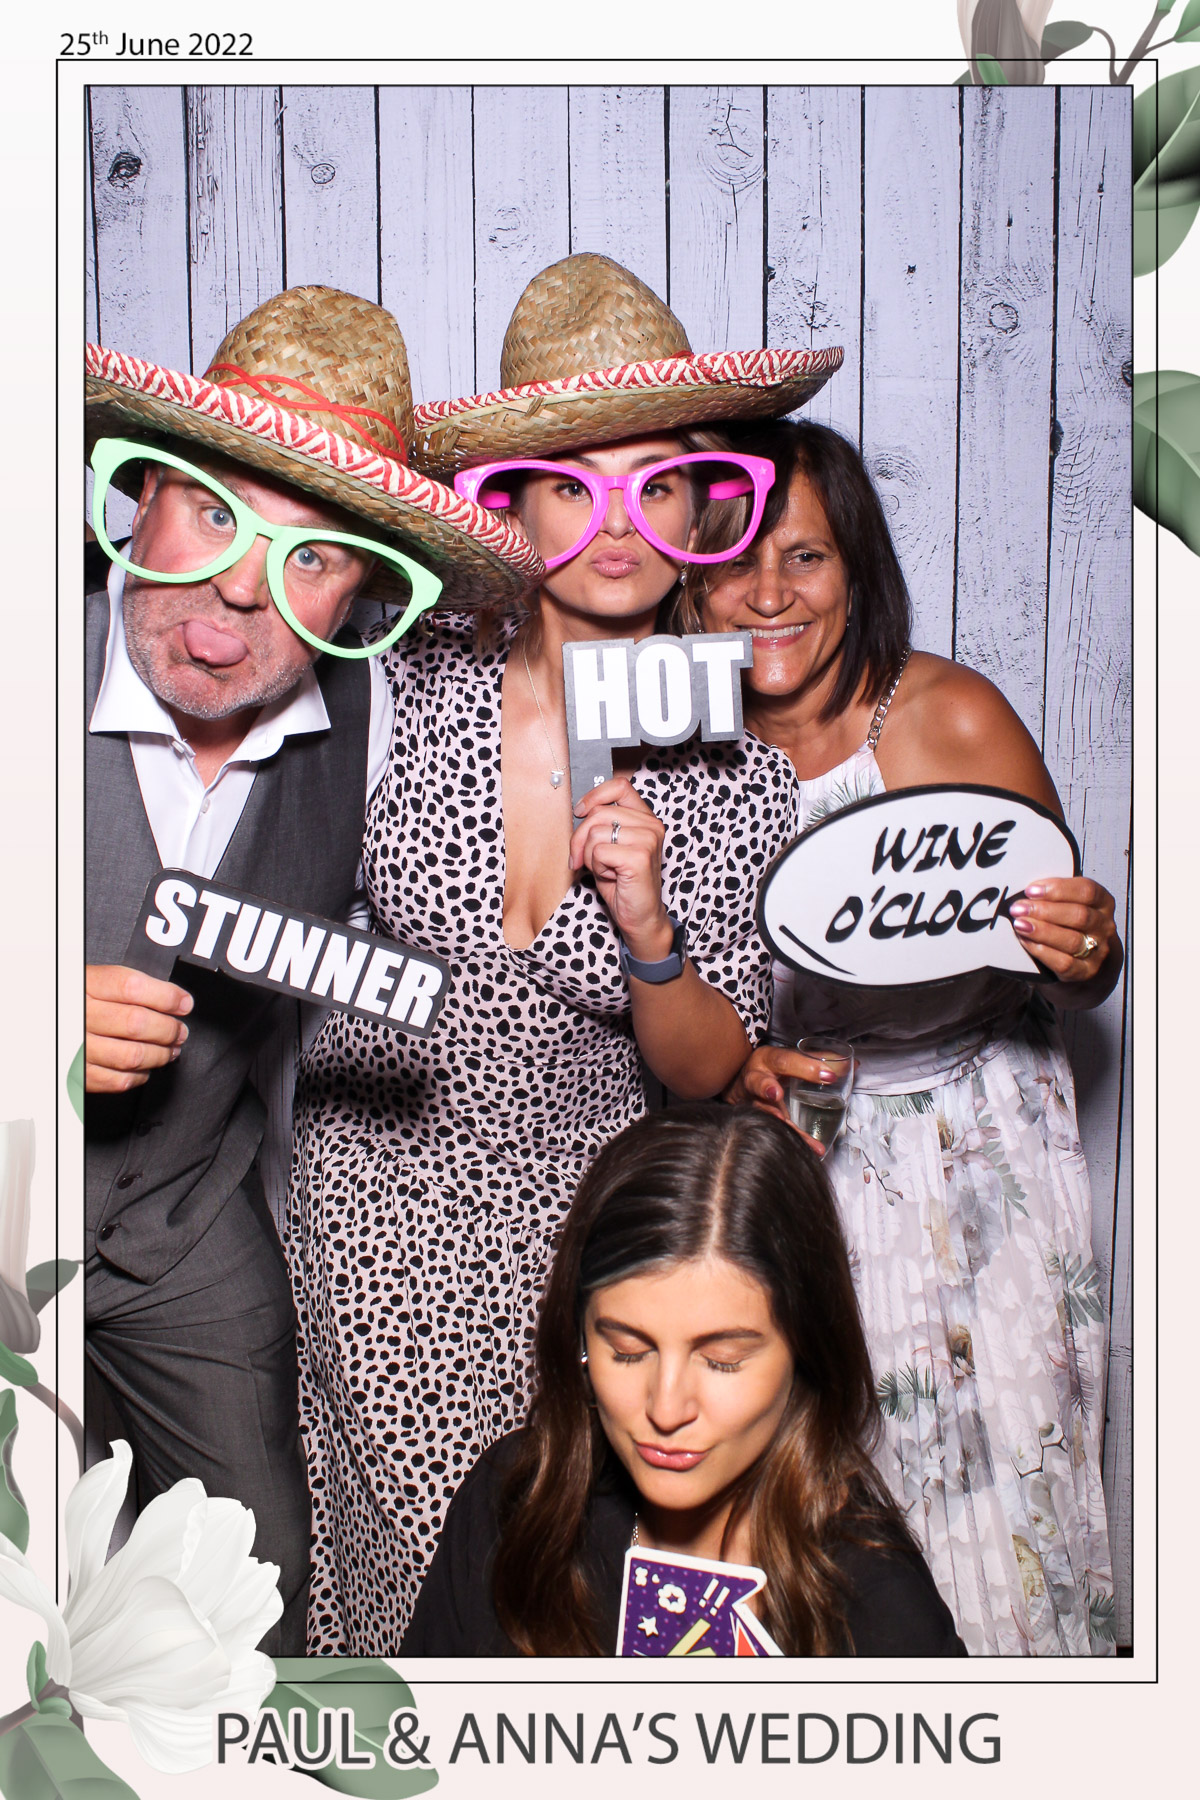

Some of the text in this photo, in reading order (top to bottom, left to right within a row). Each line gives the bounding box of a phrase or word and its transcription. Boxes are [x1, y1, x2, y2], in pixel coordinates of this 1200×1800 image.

[572, 640, 745, 741] HOT
[871, 820, 1017, 875] WINE
[145, 878, 444, 1029] STUNNER
